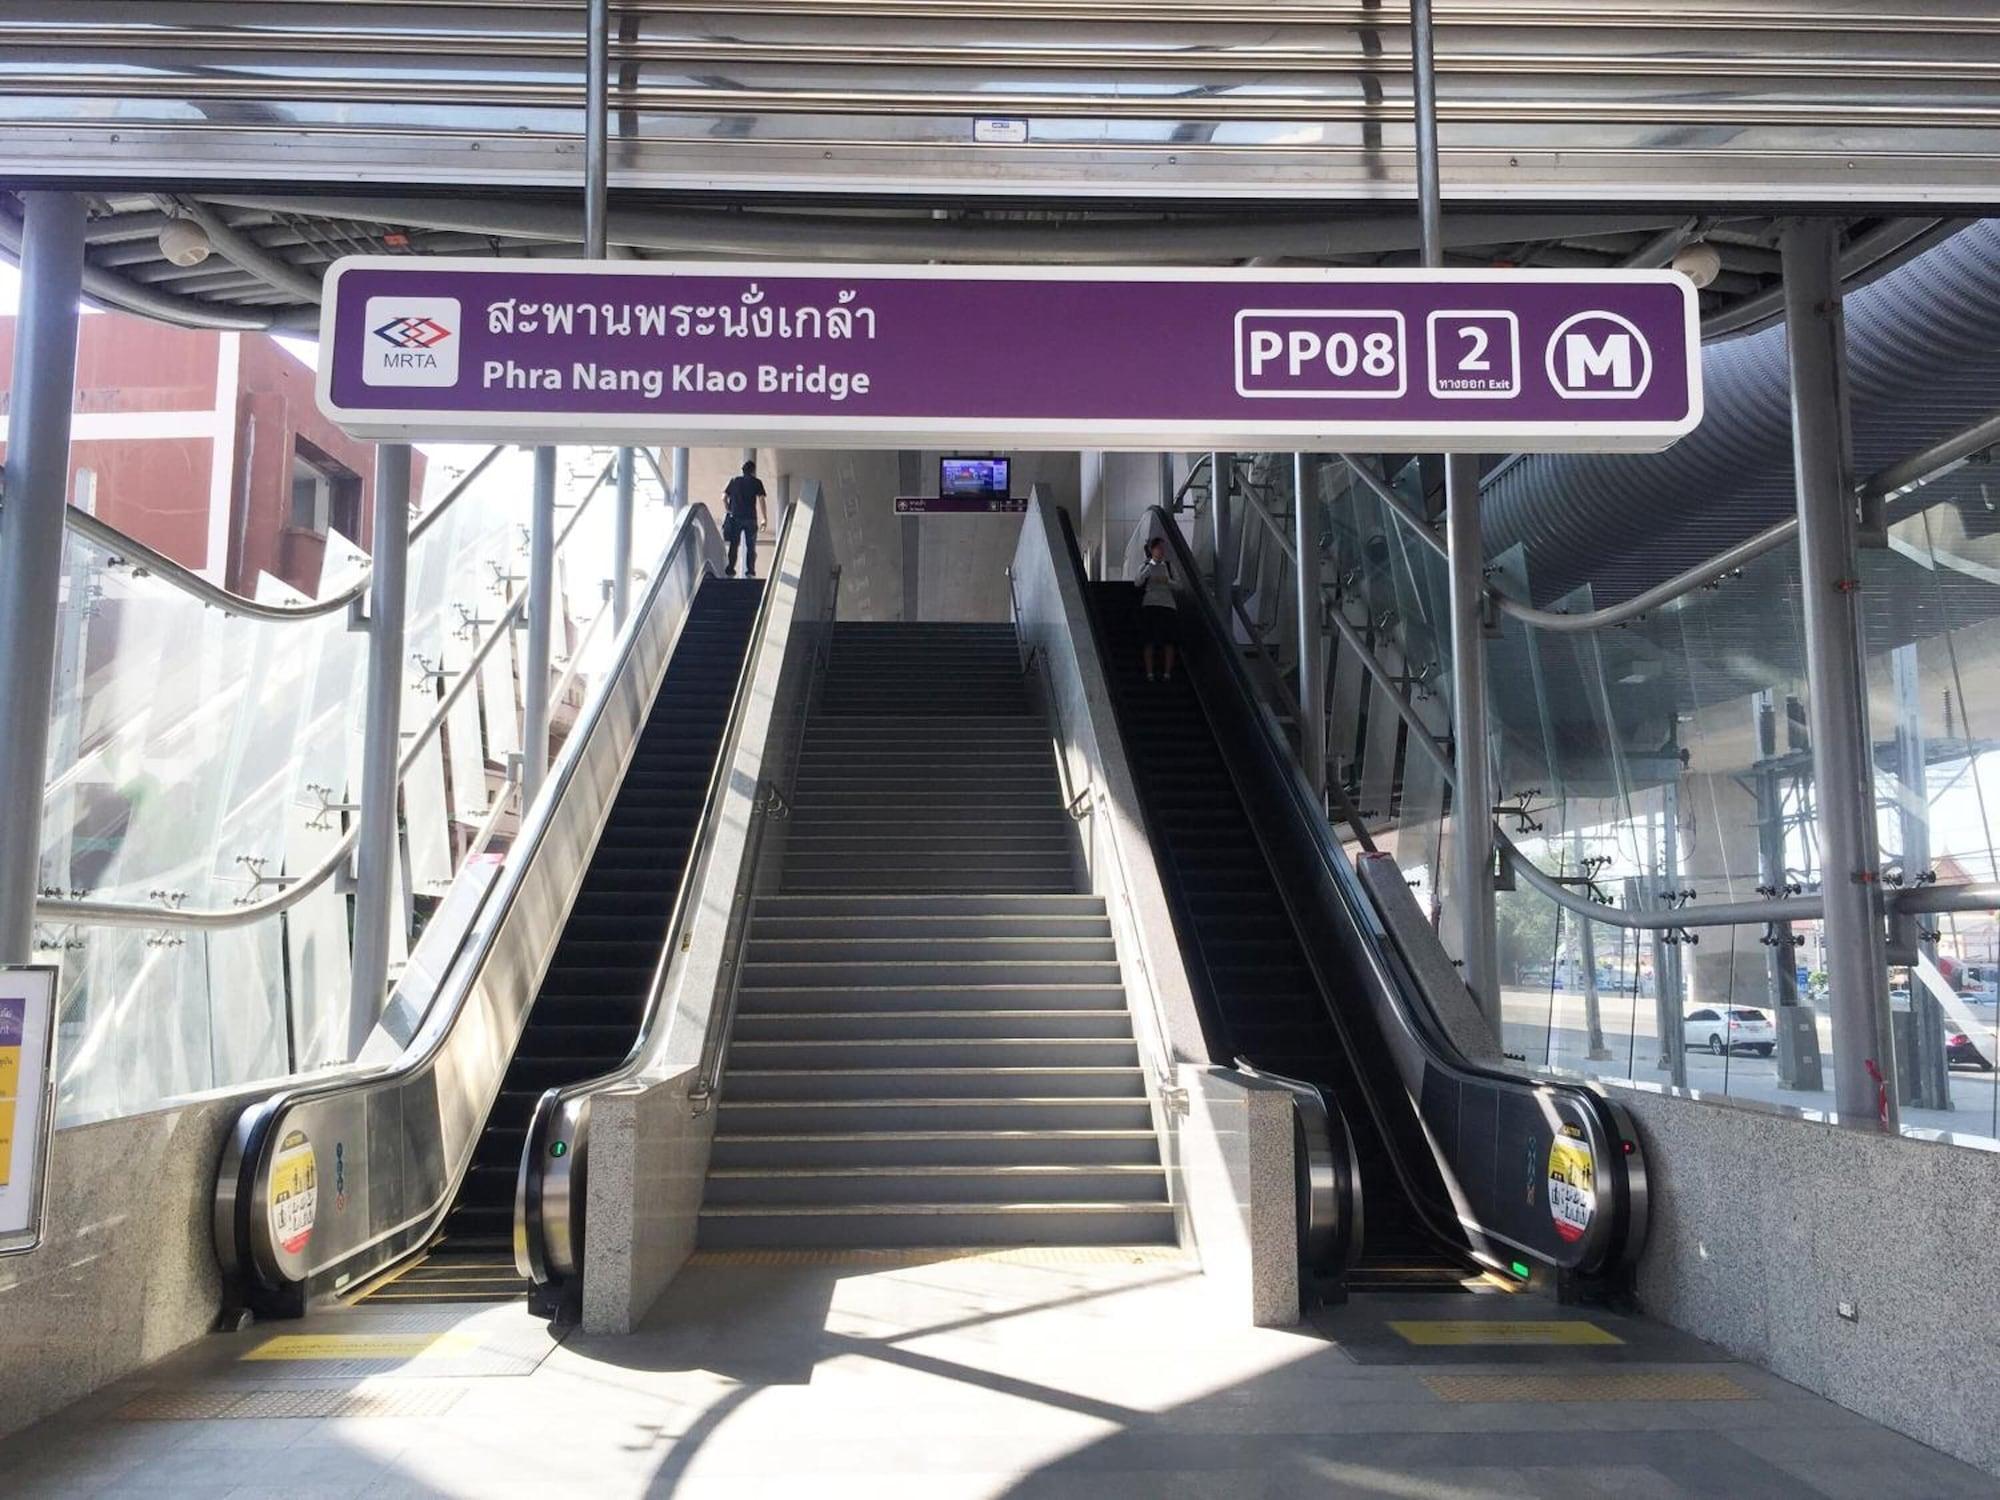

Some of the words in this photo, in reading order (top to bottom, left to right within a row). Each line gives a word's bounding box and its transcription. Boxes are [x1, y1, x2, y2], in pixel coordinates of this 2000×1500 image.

[487, 283, 875, 340] สะพานพระนั่งเกล้า
[383, 352, 438, 369] MRTA
[1250, 330, 1395, 377] PP08
[1457, 326, 1491, 371] 2
[1565, 334, 1633, 388] M
[483, 360, 562, 389] Phra
[572, 362, 663, 397] Nang
[672, 364, 748, 393] Klao
[758, 366, 871, 401] Bridge
[1438, 379, 1486, 390] ทางออก
[1488, 379, 1511, 390] Exit
